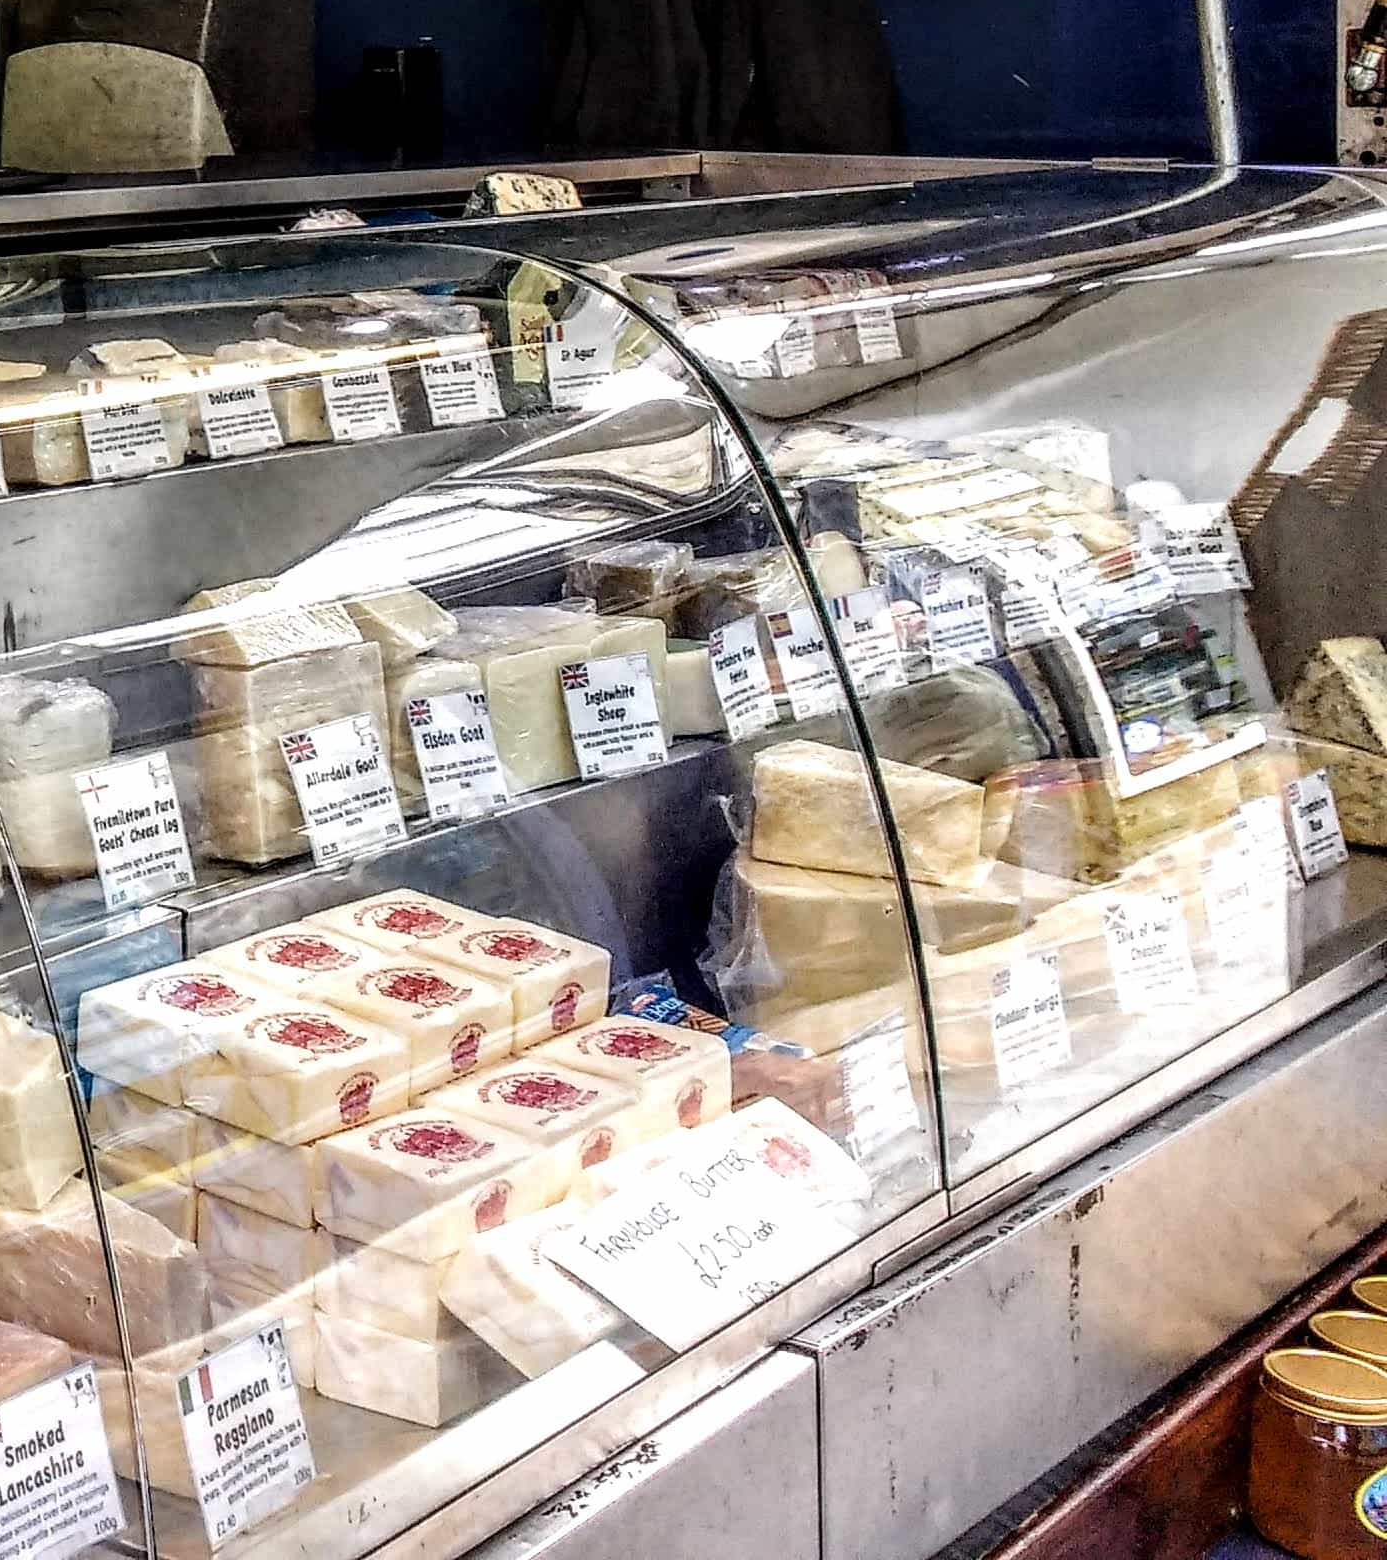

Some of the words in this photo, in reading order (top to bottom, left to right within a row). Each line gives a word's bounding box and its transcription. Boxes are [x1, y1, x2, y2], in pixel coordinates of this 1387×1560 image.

[207, 1377, 270, 1427] Parmesan
[4, 1420, 66, 1468] Smoked
[94, 1516, 119, 1536] 100g
